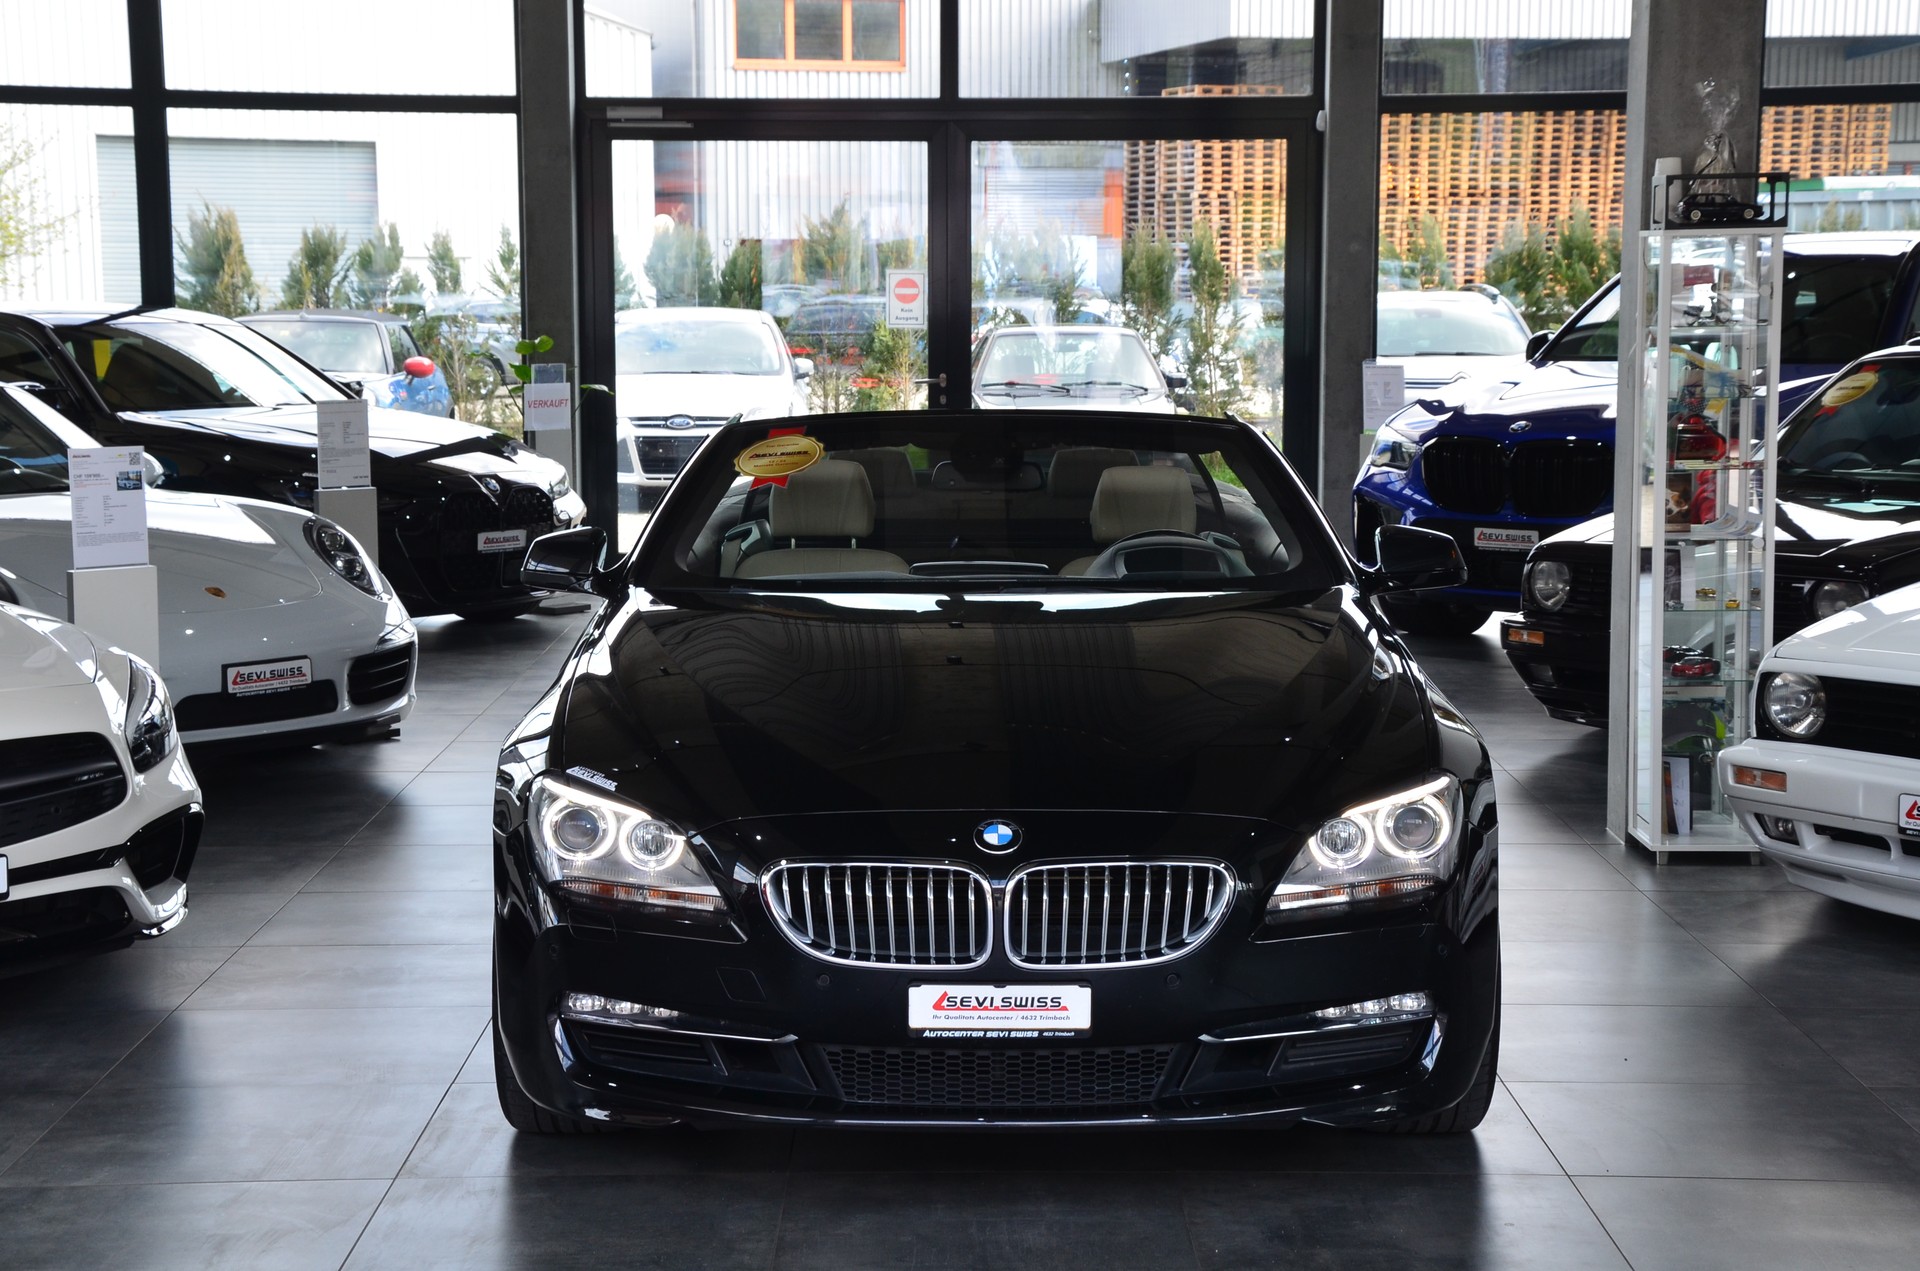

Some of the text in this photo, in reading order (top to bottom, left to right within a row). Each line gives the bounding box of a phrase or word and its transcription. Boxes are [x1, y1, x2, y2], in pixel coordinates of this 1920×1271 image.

[527, 399, 569, 409] VERKAUFT
[1482, 532, 1532, 542] SEVI SWISS
[239, 666, 304, 682] SEVI SWISS
[946, 996, 1062, 1008] SEVI SWISS
[986, 1030, 1009, 1038] SEVI
[1010, 1030, 1040, 1038] SWISS
